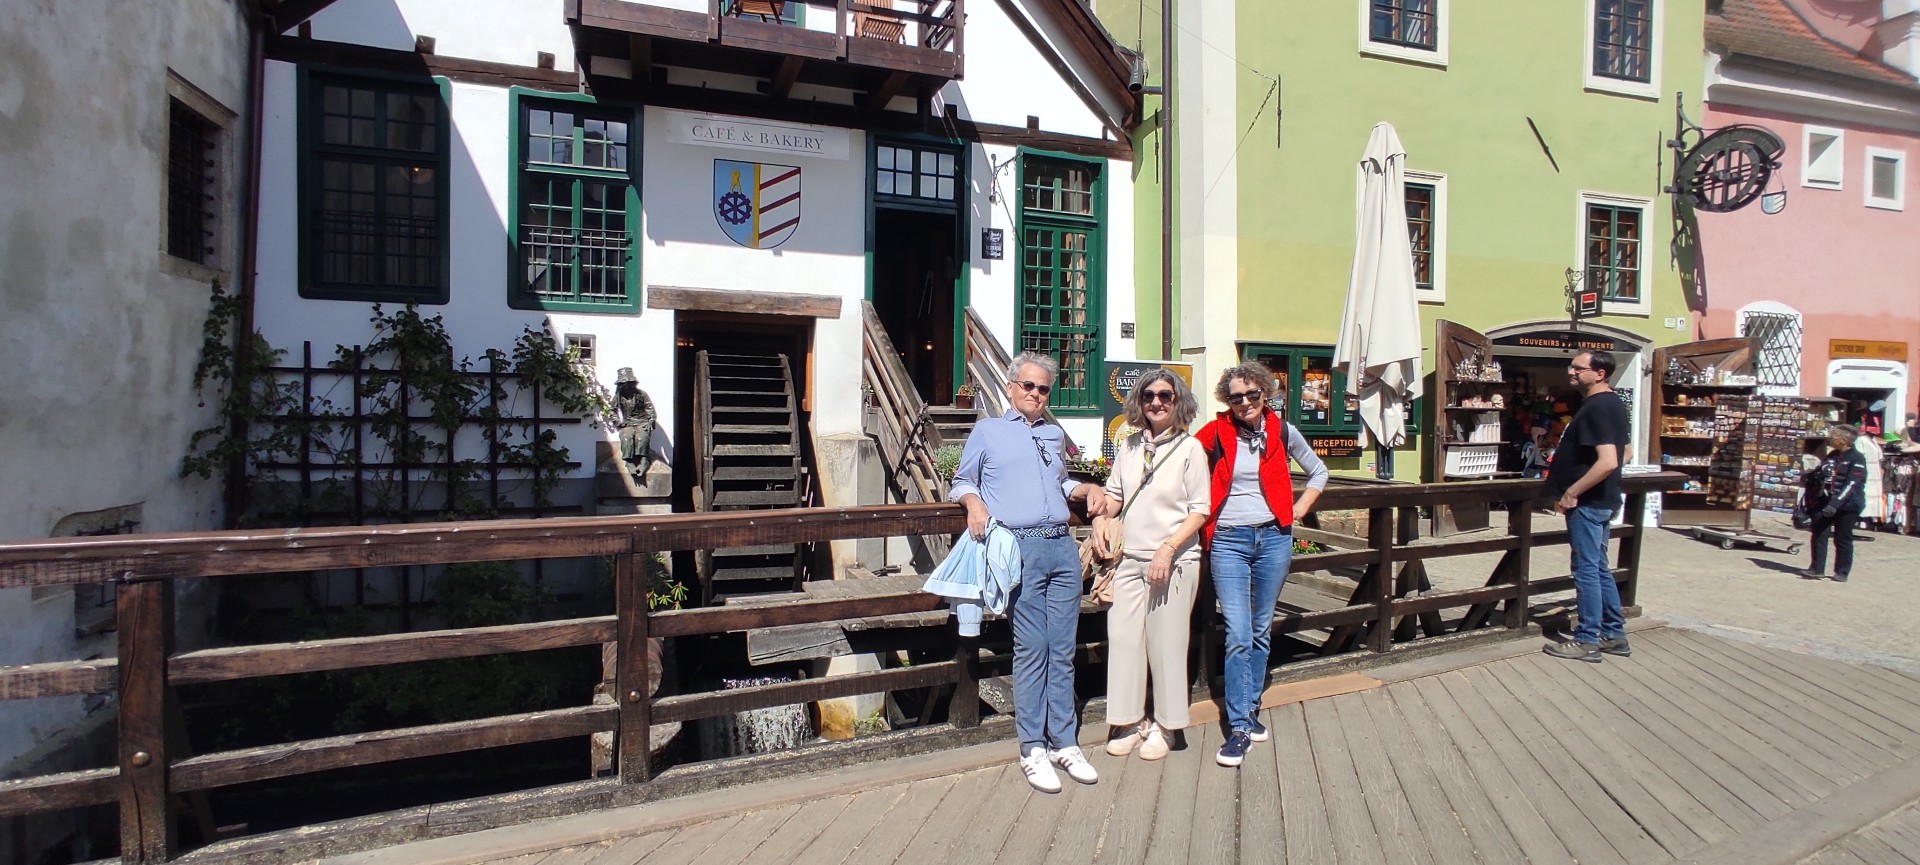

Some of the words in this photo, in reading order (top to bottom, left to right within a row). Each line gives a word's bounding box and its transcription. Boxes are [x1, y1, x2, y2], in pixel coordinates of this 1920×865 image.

[692, 125, 736, 141] CAFÉ
[742, 131, 754, 143] &
[760, 132, 824, 150] BAKERY
[1520, 338, 1560, 346] SOUVENIRS
[1313, 439, 1358, 447] RECEPTION
